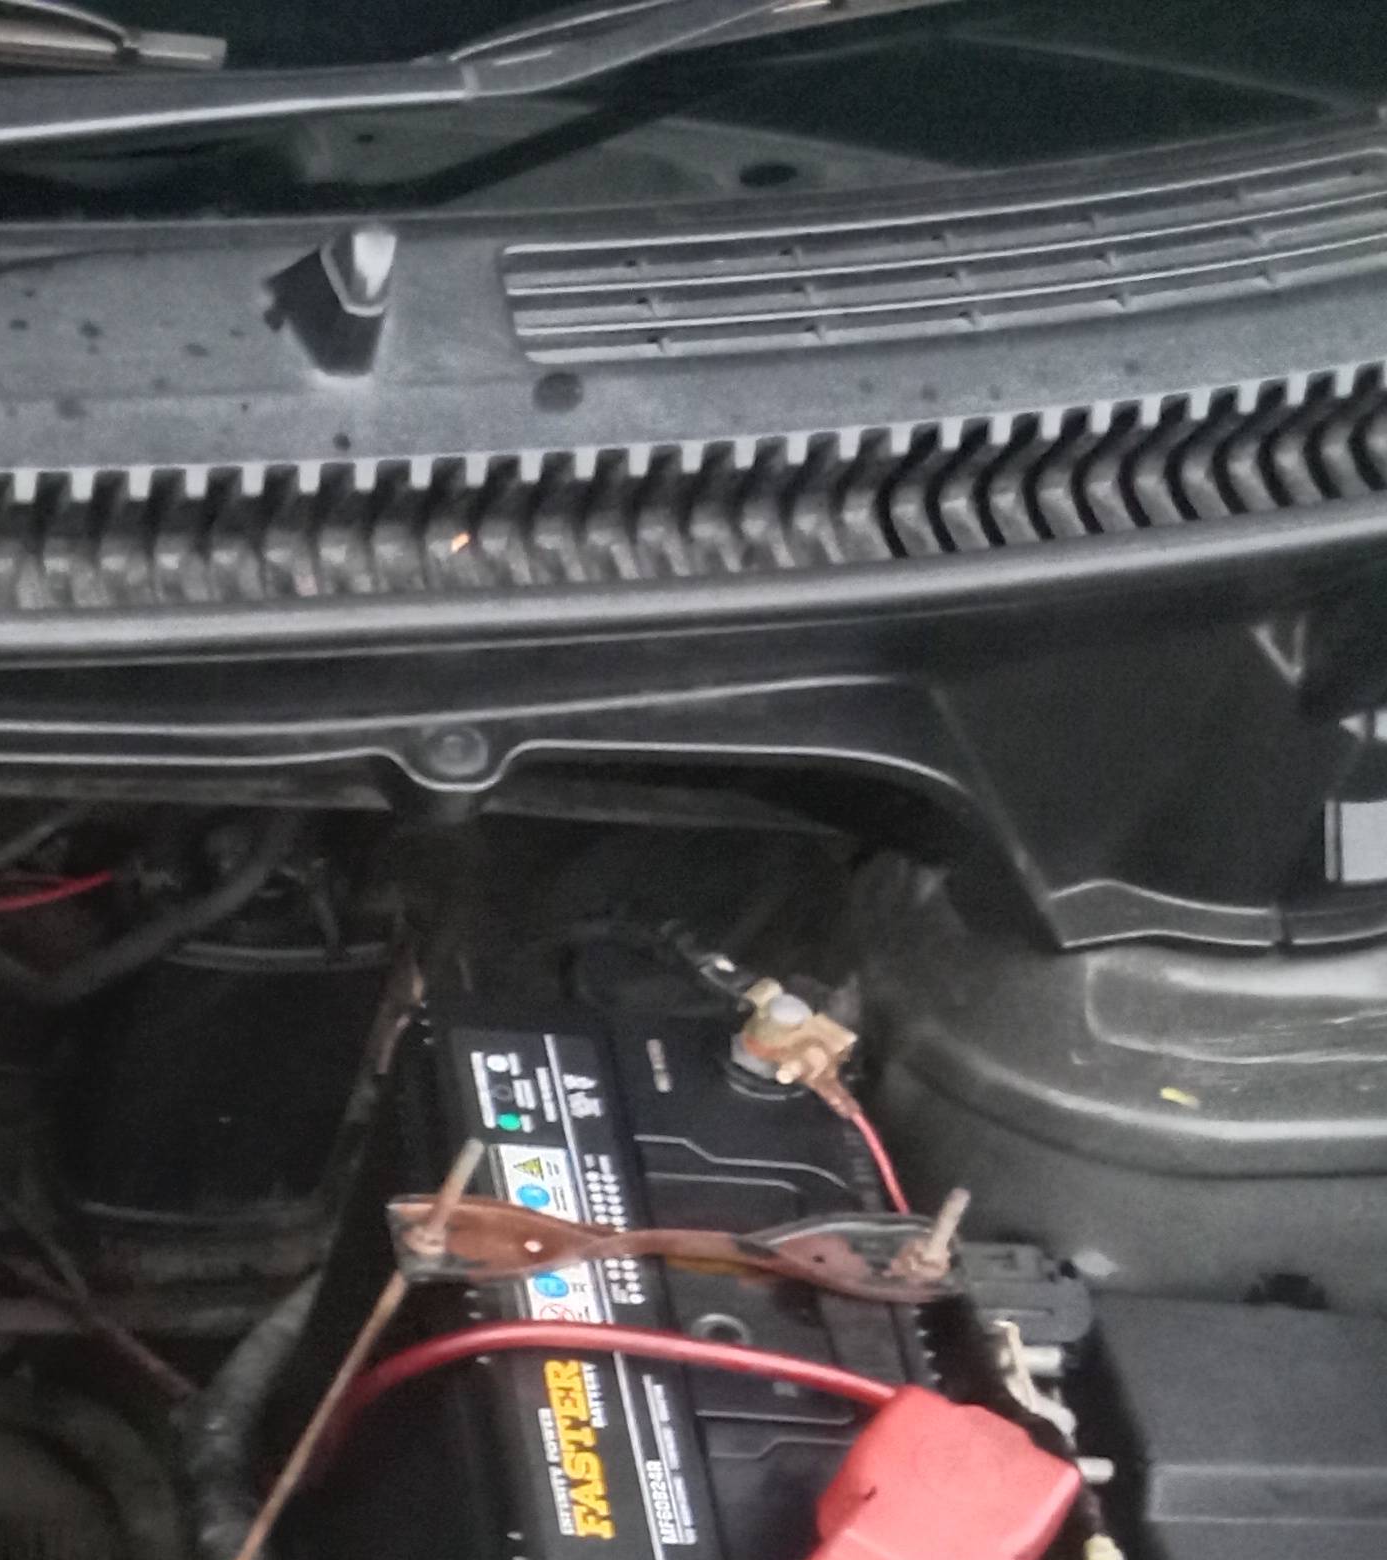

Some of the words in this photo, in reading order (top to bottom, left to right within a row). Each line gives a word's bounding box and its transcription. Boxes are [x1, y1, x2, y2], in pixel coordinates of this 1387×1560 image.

[581, 1362, 608, 1428] BATTERY
[538, 1408, 559, 1462] POWER
[544, 1359, 615, 1539] FASTER
